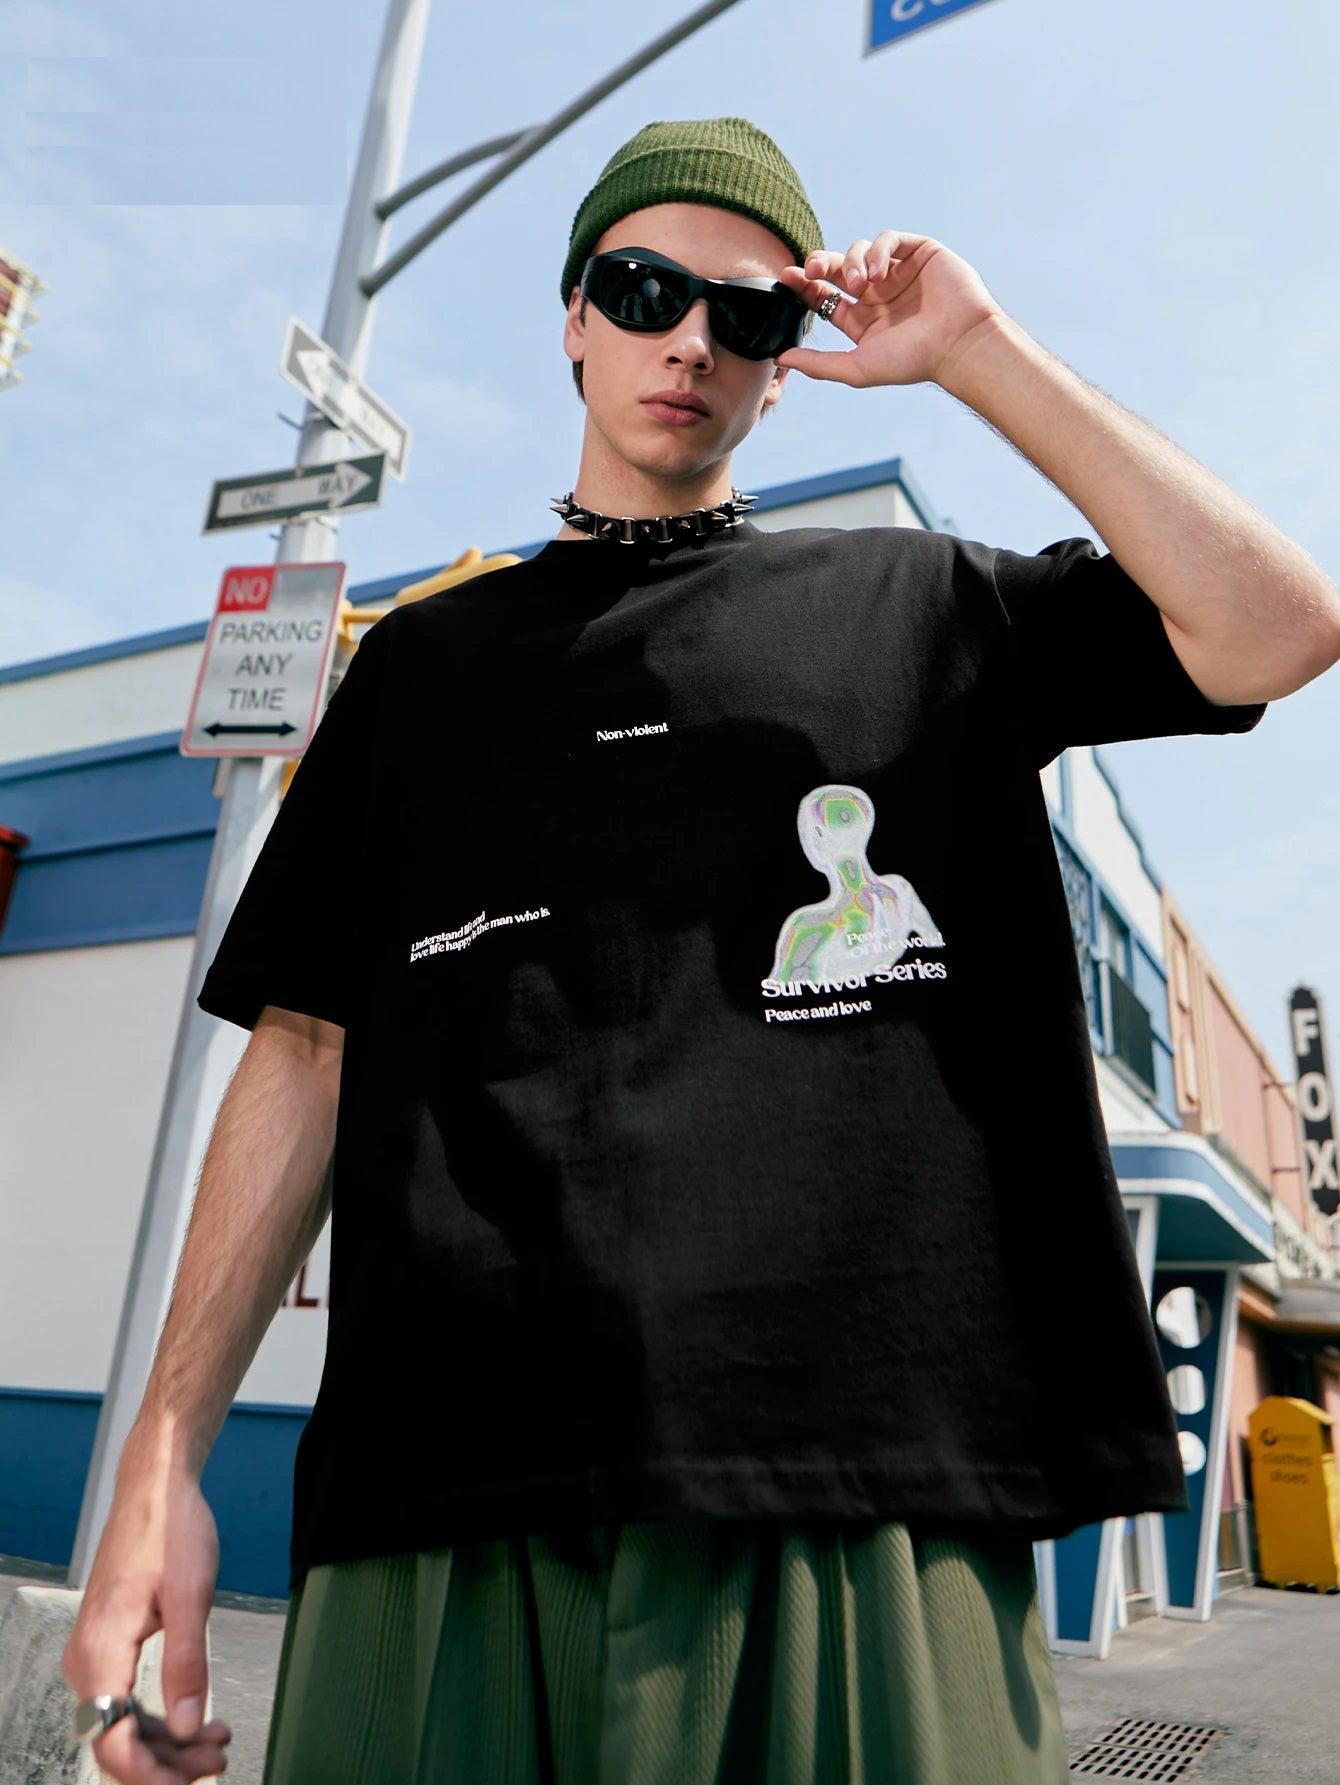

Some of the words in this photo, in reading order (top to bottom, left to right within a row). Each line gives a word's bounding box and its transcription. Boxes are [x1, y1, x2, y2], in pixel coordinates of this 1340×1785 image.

[240, 490, 276, 512] ONE
[318, 473, 356, 496] WAY
[224, 576, 270, 605] NO
[219, 620, 324, 645] PARKING
[235, 653, 294, 677] ANY
[227, 687, 287, 712] TIME
[596, 722, 669, 742] Non-violent
[410, 948, 429, 962] love
[429, 941, 445, 954] life
[445, 936, 472, 951] happy
[477, 921, 490, 935] the
[490, 915, 514, 929] man
[514, 910, 540, 923] who
[411, 926, 464, 952] Understand
[761, 972, 870, 998] Survivor
[874, 958, 947, 983] Series
[765, 1006, 810, 1022] Peace
[810, 1002, 839, 1018] and
[840, 1000, 872, 1016] love
[1293, 1008, 1338, 1191] FOX
